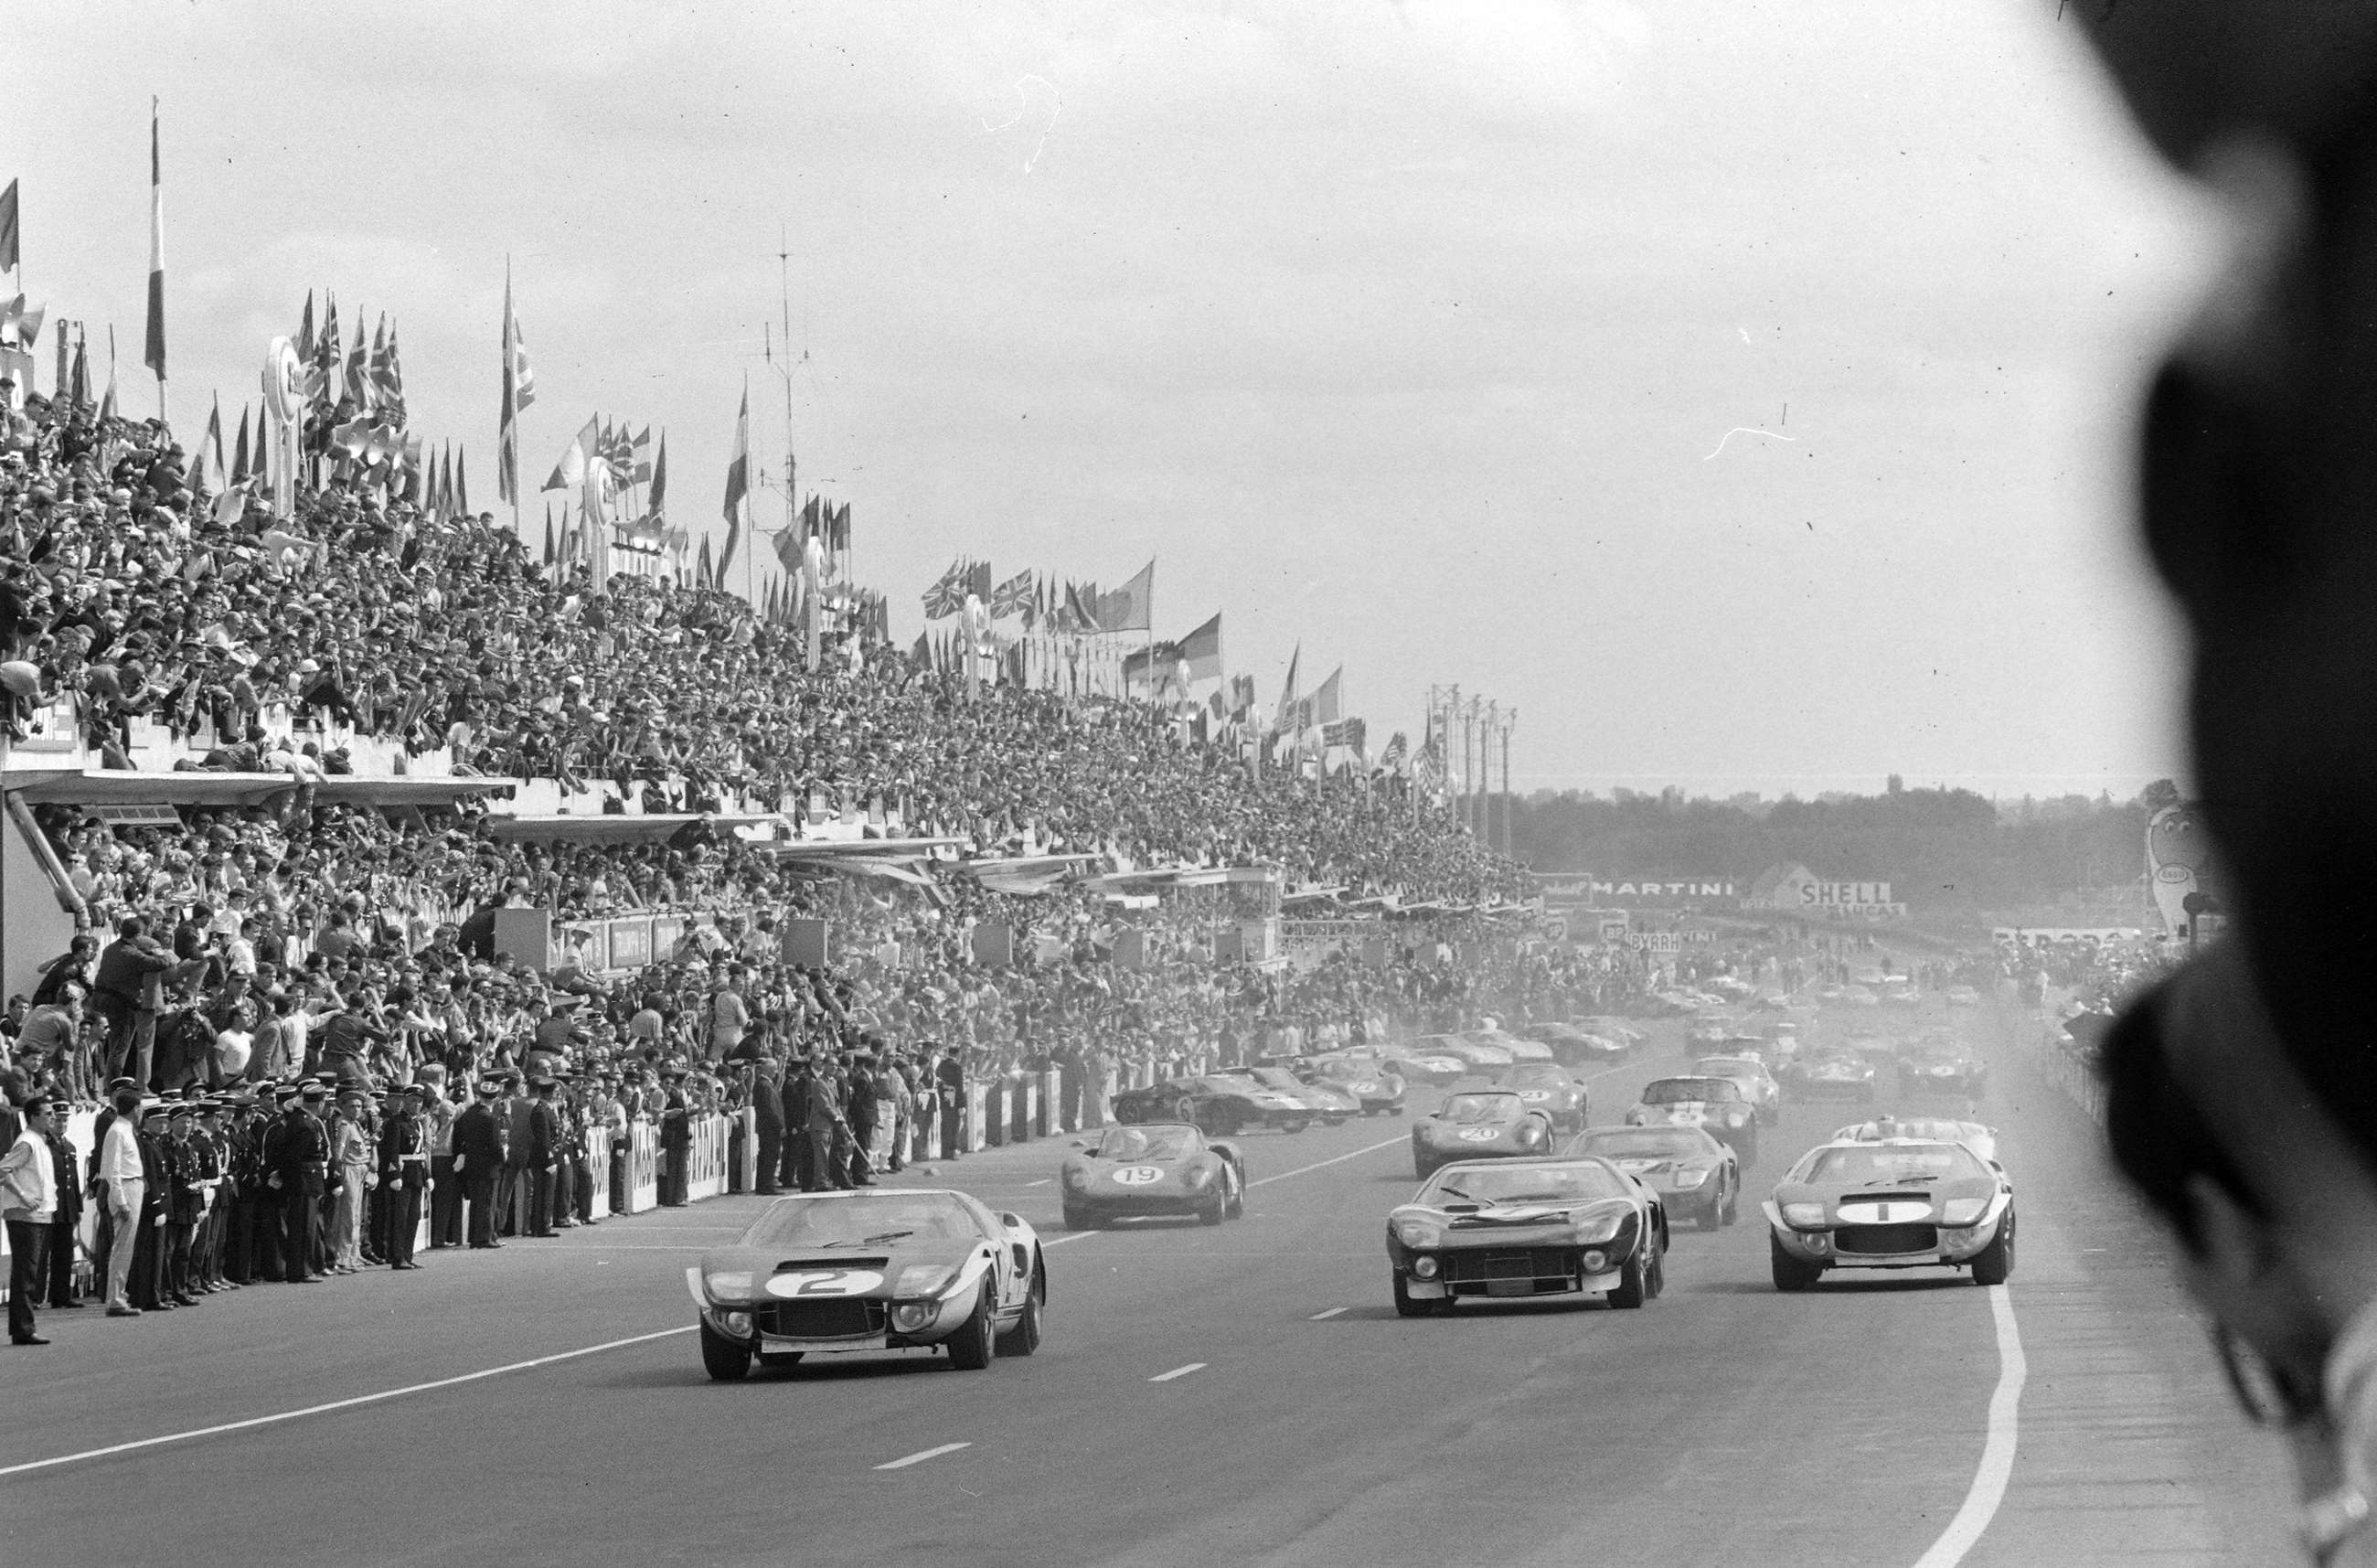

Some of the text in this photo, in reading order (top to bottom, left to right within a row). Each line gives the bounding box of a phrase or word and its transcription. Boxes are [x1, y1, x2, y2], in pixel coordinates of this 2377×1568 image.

[1593, 882, 1732, 895] MARTINI
[1802, 884, 1886, 904] SHELL
[1606, 927, 1624, 939] BP
[1631, 934, 1679, 951] BYRRH
[1520, 1091, 1542, 1099] 21
[1466, 1128, 1496, 1139] 20
[633, 1129, 656, 1190] Mobil
[1124, 1167, 1157, 1183] 19
[1878, 1203, 1889, 1221] 1
[797, 1270, 847, 1295] 2
